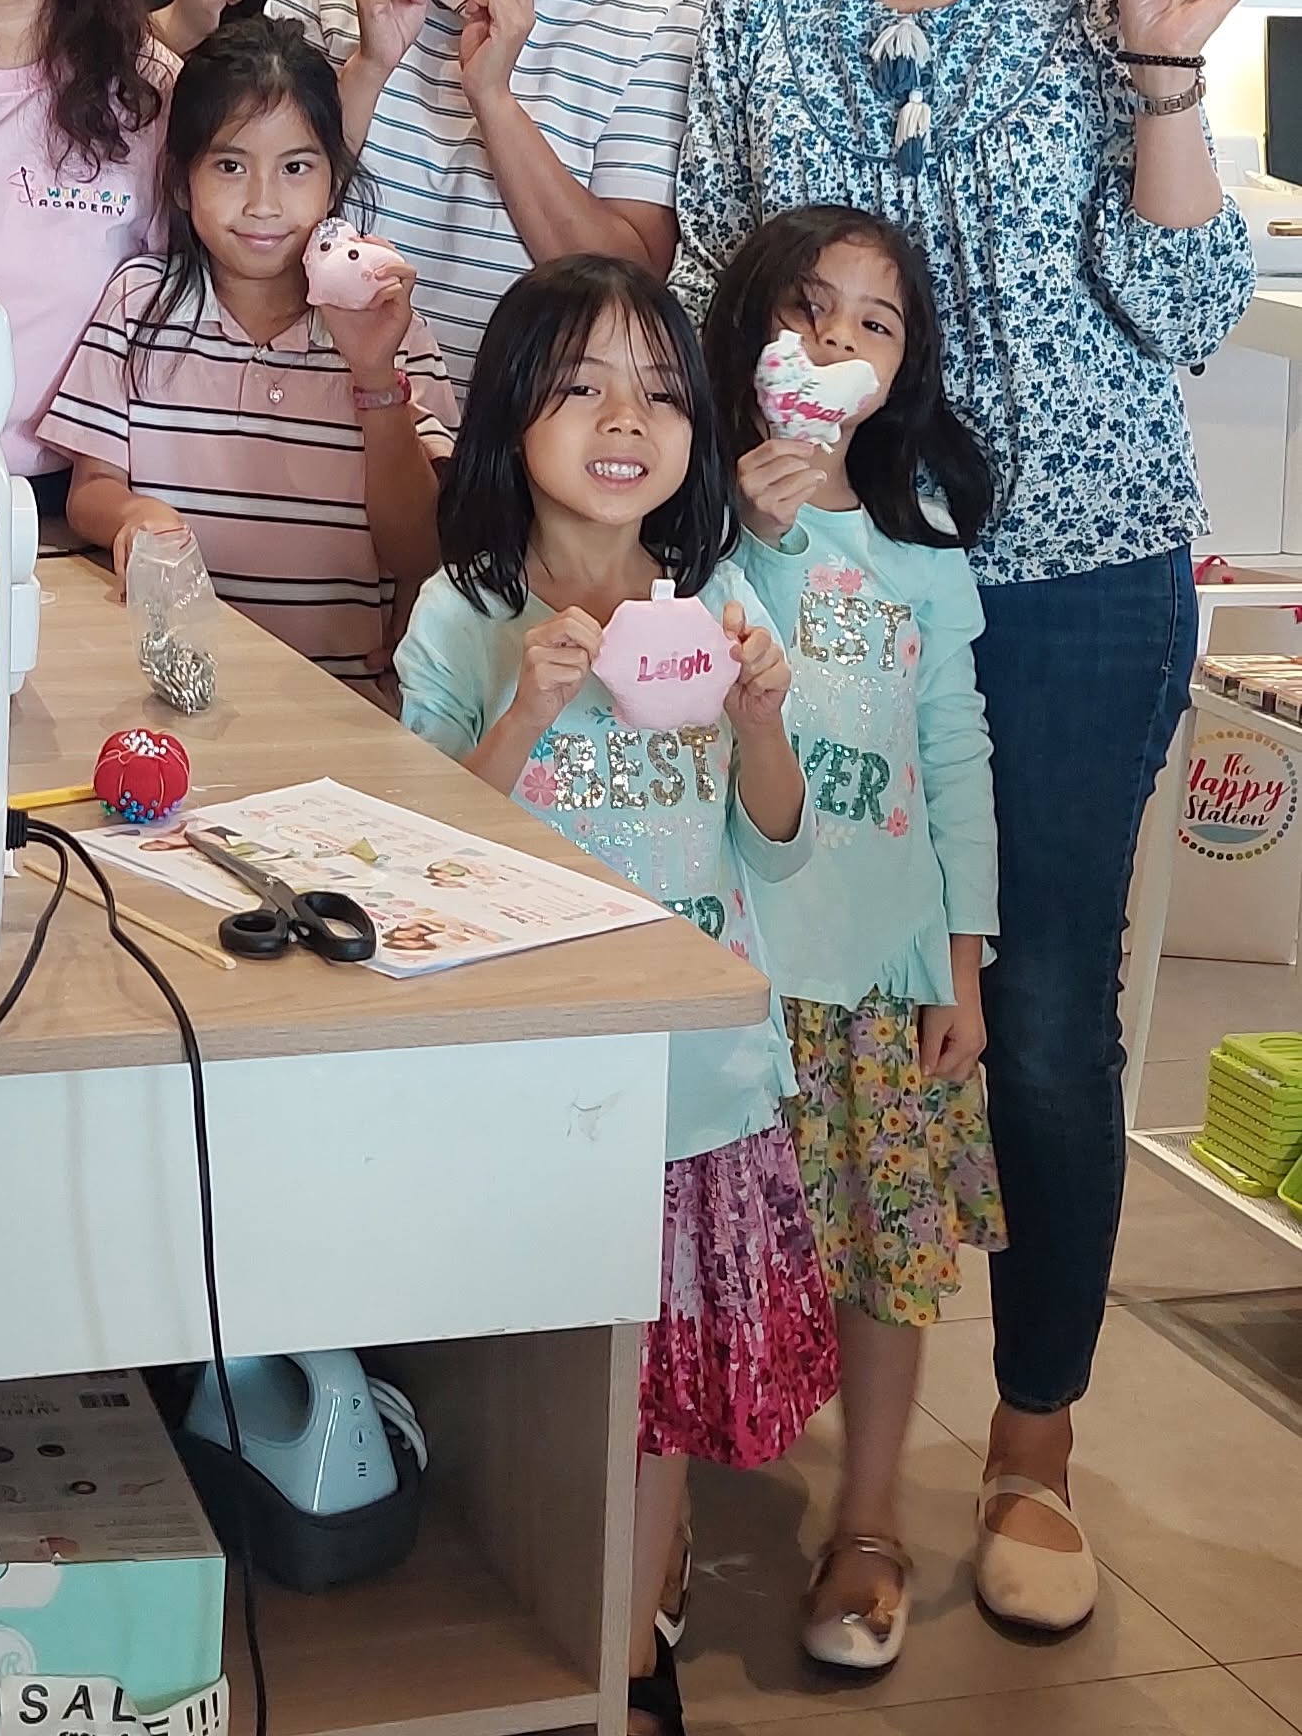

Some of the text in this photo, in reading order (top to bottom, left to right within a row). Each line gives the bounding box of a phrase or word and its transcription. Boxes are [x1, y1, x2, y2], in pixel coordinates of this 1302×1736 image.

[39, 198, 126, 217] ACADEMY
[790, 589, 912, 672] EST
[636, 646, 713, 682] Leigh
[548, 723, 720, 811] BEST
[1222, 753, 1255, 778] The
[1184, 794, 1271, 826] Station
